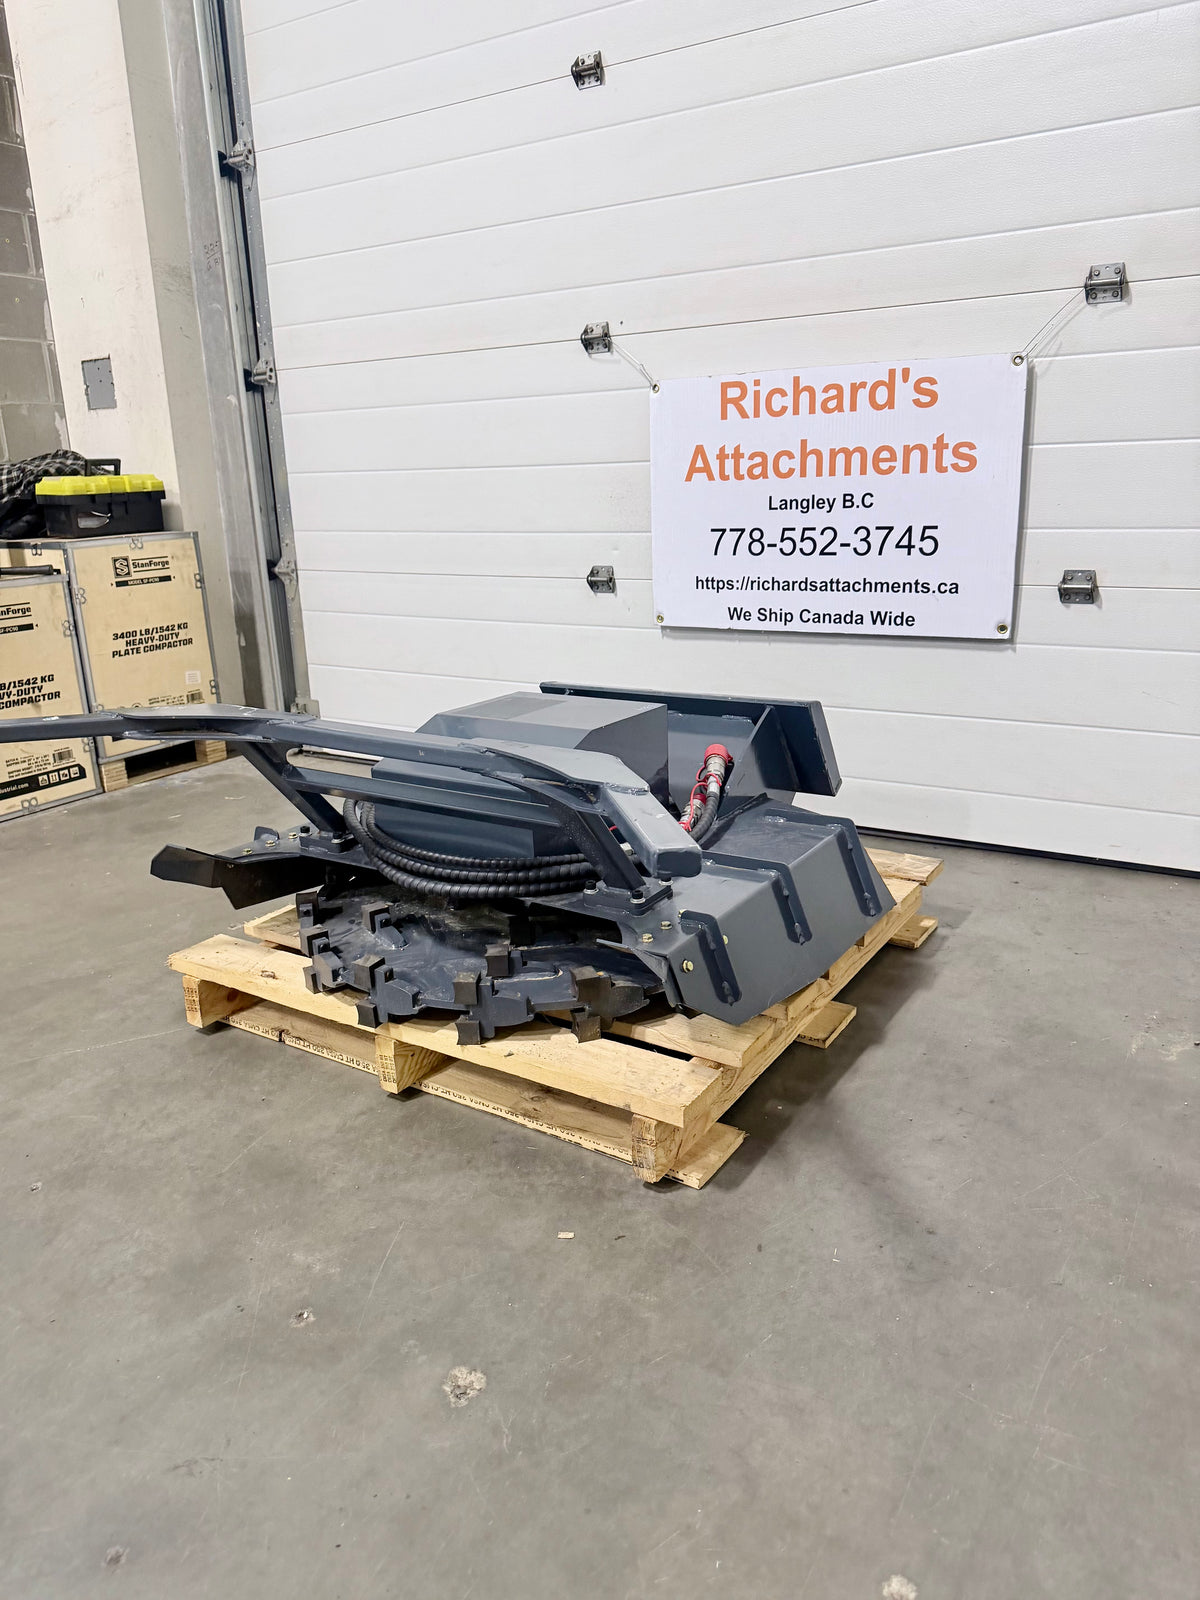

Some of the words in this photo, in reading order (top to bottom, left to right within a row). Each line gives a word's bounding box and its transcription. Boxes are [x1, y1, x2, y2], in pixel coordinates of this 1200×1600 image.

[720, 367, 939, 421] Richard's
[684, 432, 979, 483] Attachments
[768, 495, 836, 513] Langley
[842, 493, 874, 509] B.C
[710, 525, 939, 557] 778-552-3745
[132, 560, 170, 570] StanForge
[695, 576, 960, 595] https://richardsattachments.ca
[727, 606, 752, 621] We
[757, 608, 794, 625] Ship
[799, 608, 864, 626] Canada
[870, 611, 916, 627] Wide
[112, 630, 138, 641] 3400
[140, 624, 176, 637] LB/1542
[178, 622, 188, 630] KG
[126, 632, 180, 648] HEAVY-DUTY
[112, 646, 141, 658] PLATE
[144, 638, 193, 653] COMPACTOR
[41, 674, 54, 684] KG
[0, 690, 60, 710] COMPACTOR
